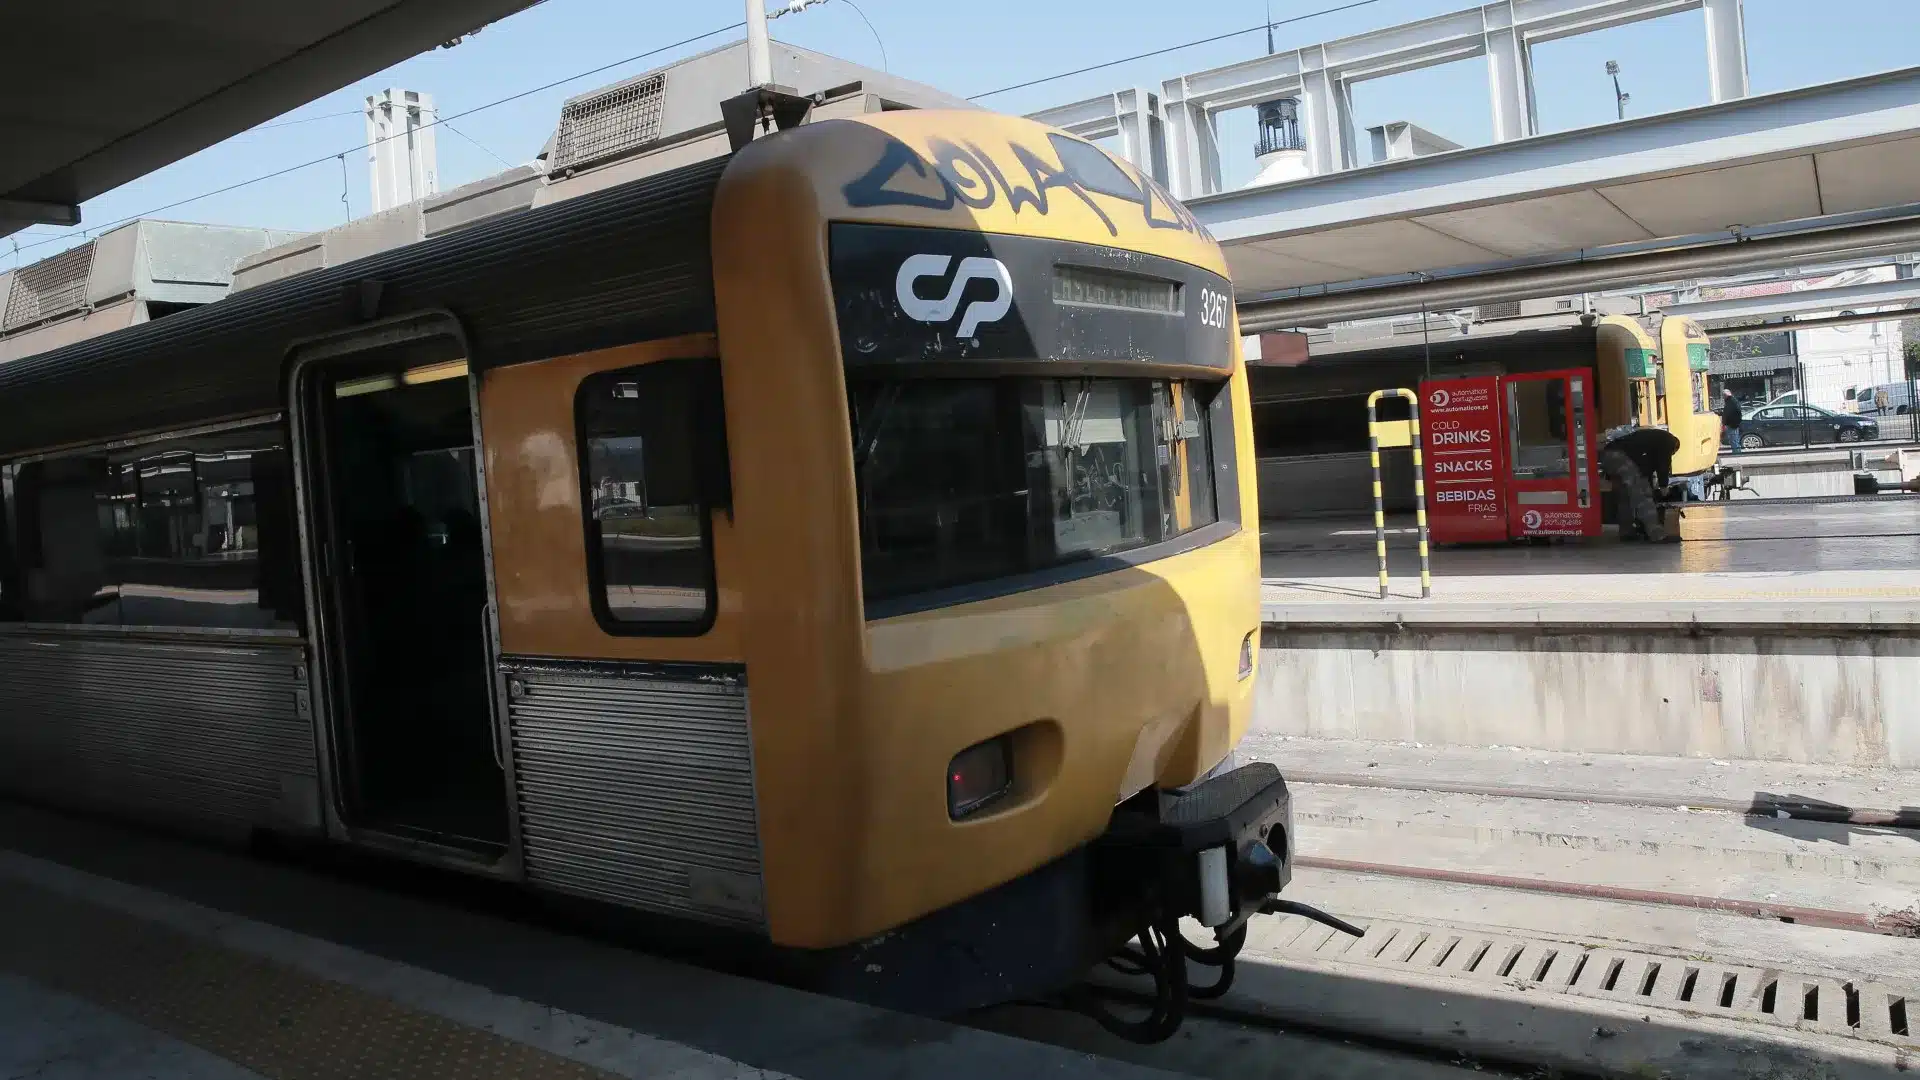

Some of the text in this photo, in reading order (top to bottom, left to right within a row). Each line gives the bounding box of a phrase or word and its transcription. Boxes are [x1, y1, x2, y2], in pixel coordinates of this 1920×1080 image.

[895, 254, 1013, 337] CP
[1200, 288, 1228, 330] 3267
[1430, 404, 1489, 413] www.automaticos.pt
[1431, 420, 1460, 430] COLD
[1432, 429, 1491, 445] DRINKS
[1434, 459, 1493, 473] SNACKS
[1436, 489, 1496, 502] BEBIDAS
[1468, 503, 1497, 512] FRIAS
